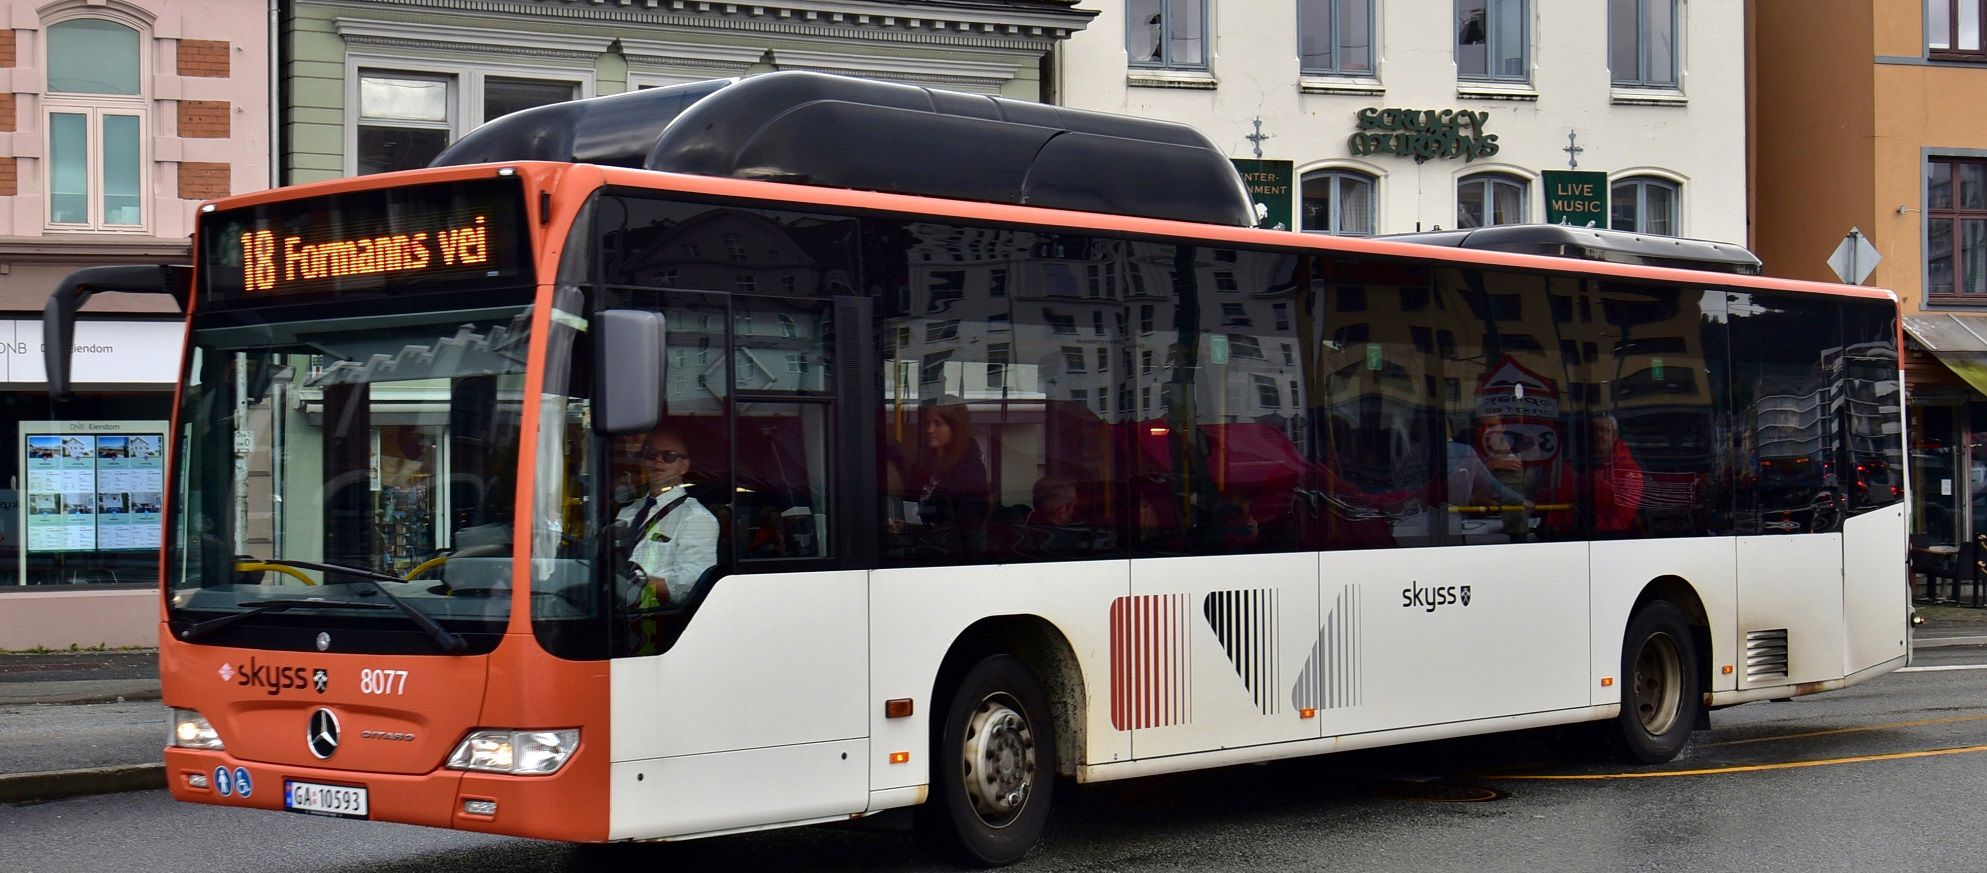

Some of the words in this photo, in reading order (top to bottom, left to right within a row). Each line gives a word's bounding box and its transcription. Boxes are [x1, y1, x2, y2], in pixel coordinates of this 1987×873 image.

[1247, 185, 1288, 195] NMENT
[1557, 183, 1593, 196] LIVE
[1552, 199, 1601, 213] MUSIC
[240, 230, 276, 291] 18
[284, 232, 431, 281] Formanns
[437, 215, 488, 266] vei
[88, 423, 121, 431] Eiendom
[1402, 580, 1457, 613] skyss
[237, 656, 308, 695] skyss
[360, 668, 409, 695] 8077
[294, 785, 312, 807] GA
[318, 788, 360, 811] 10593
